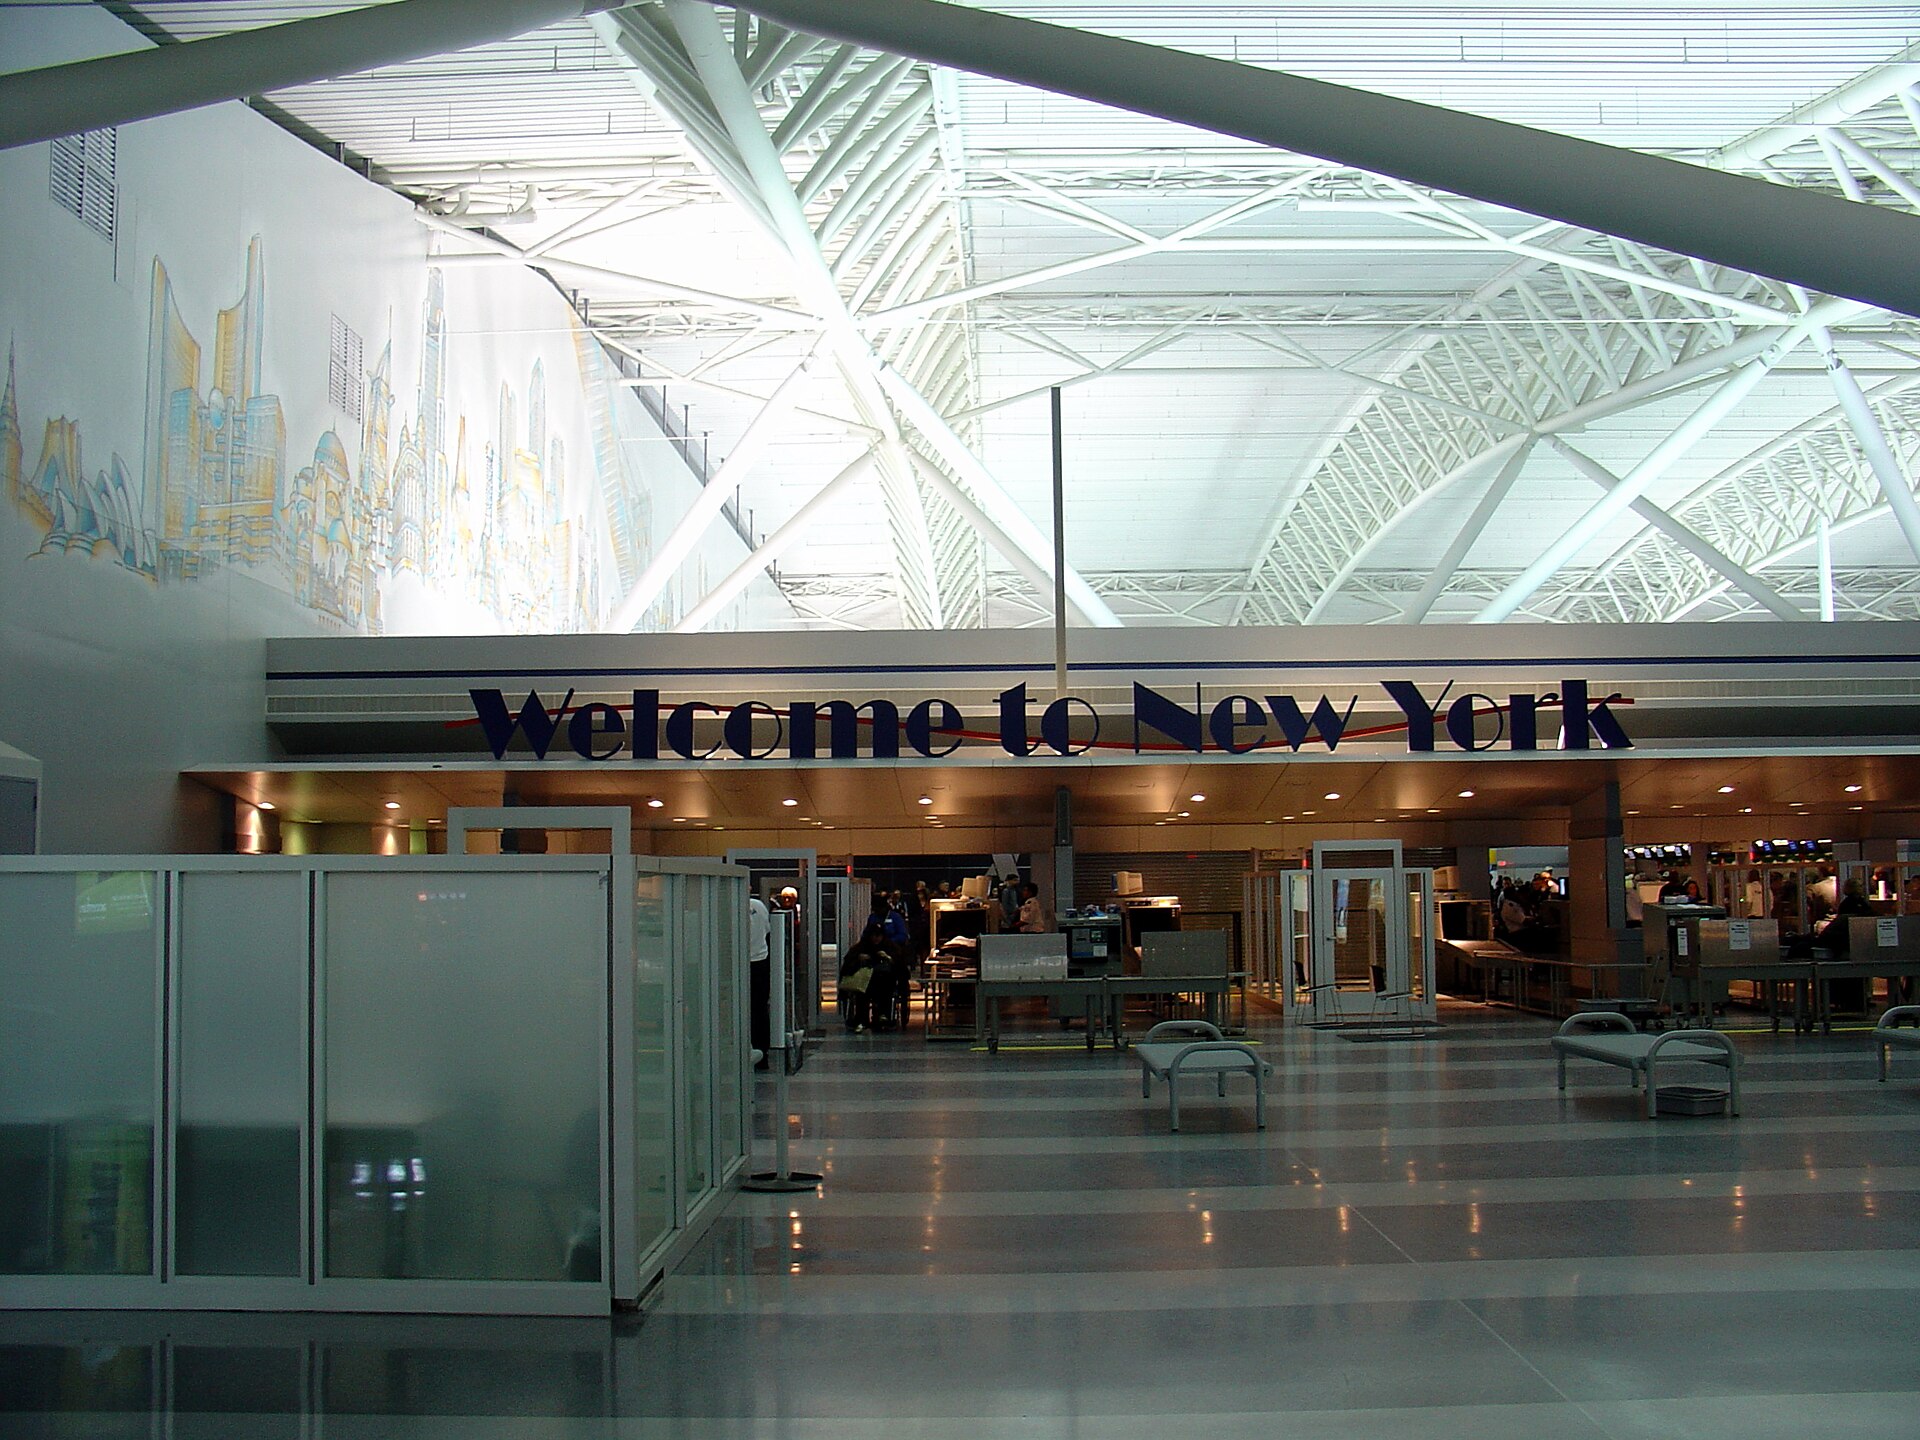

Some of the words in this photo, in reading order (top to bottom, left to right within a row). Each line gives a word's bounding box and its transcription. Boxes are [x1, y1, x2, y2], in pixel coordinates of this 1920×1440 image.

[469, 687, 965, 761] Welcome
[991, 681, 1099, 757] to
[1133, 681, 1359, 755] New
[1380, 678, 1635, 751] York
